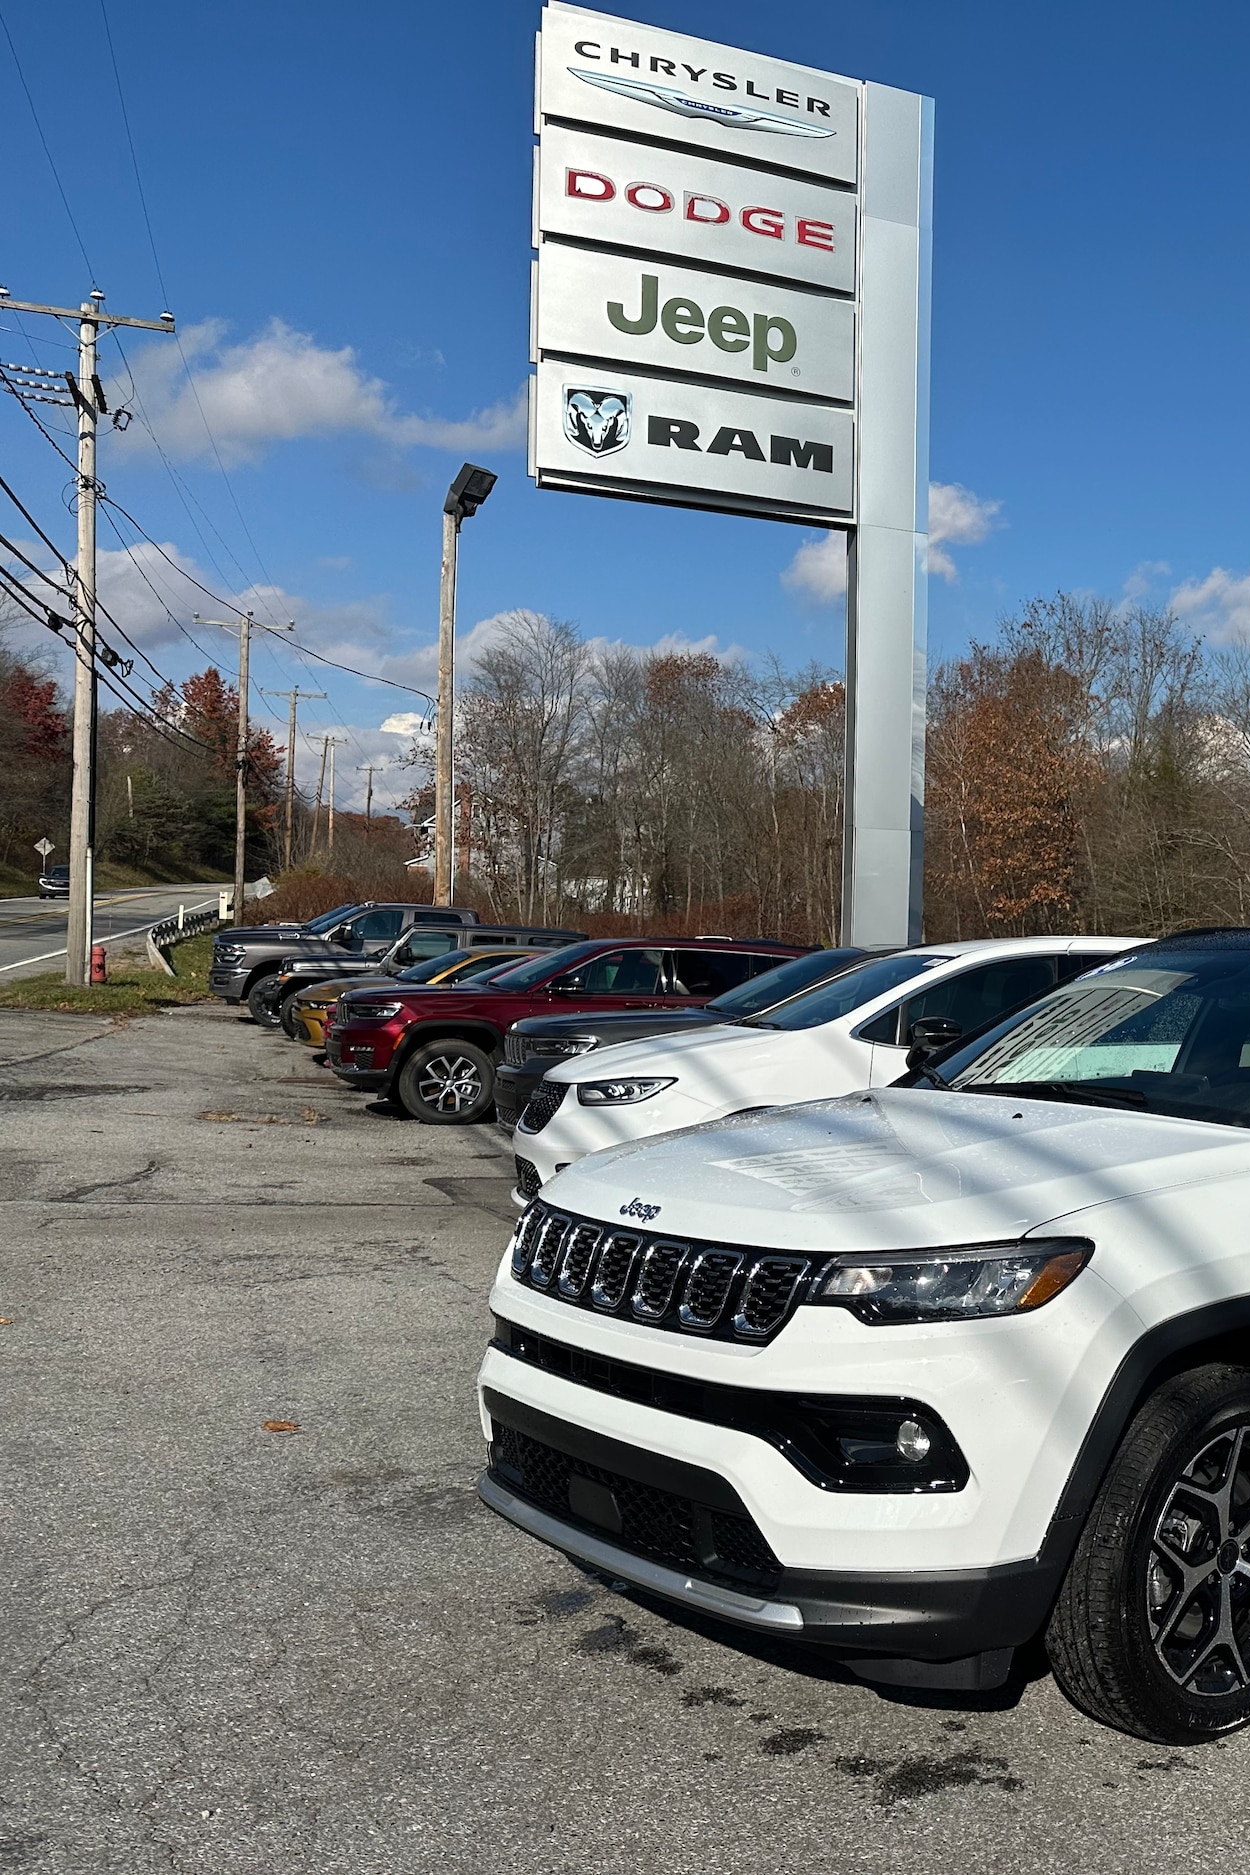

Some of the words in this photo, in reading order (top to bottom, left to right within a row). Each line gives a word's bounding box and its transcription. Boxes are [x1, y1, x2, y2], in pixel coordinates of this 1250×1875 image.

[574, 40, 832, 118] CHRYSLER
[565, 167, 836, 253] DODGE
[606, 273, 798, 372] Jeep
[647, 415, 834, 474] RAM
[619, 1197, 662, 1224] Jeep
